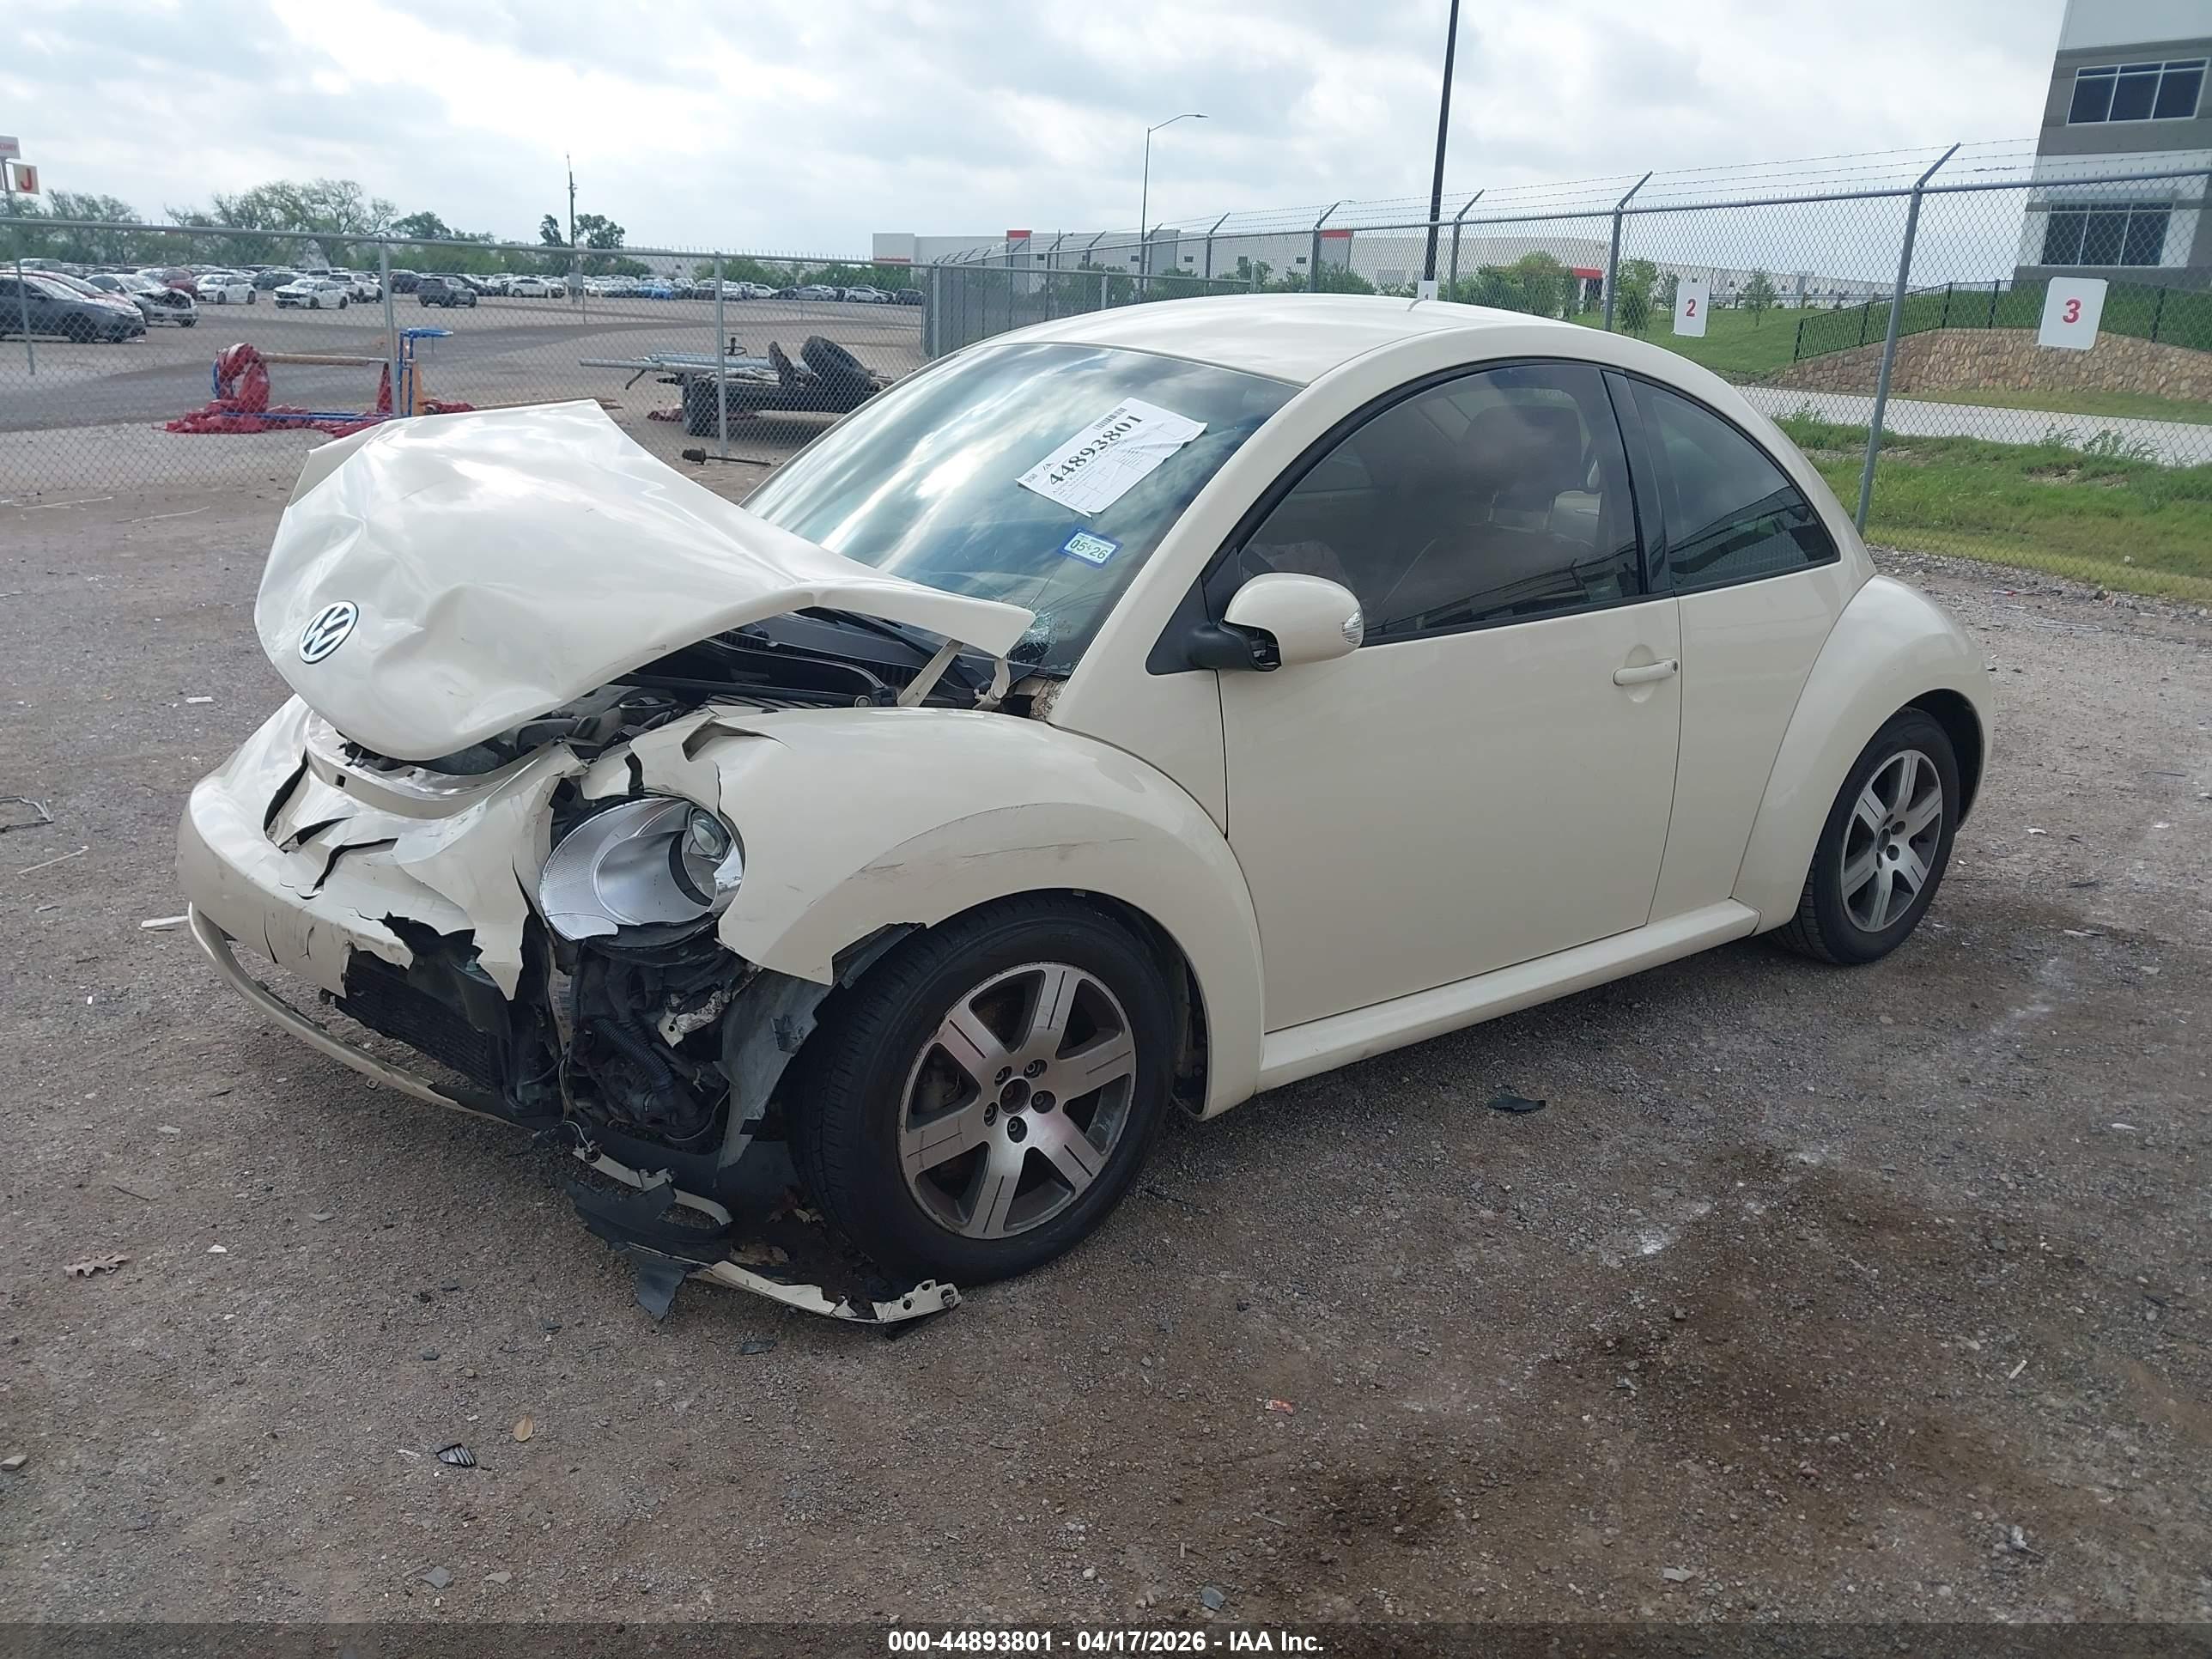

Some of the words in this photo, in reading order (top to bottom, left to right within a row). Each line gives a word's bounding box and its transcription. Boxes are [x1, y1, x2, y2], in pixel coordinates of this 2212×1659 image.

[20, 167, 33, 191] J
[1685, 297, 1698, 318] 2
[2062, 298, 2081, 324] 3
[1048, 414, 1144, 487] 44893801
[1069, 538, 1089, 552] 05
[1089, 546, 1109, 560] 26
